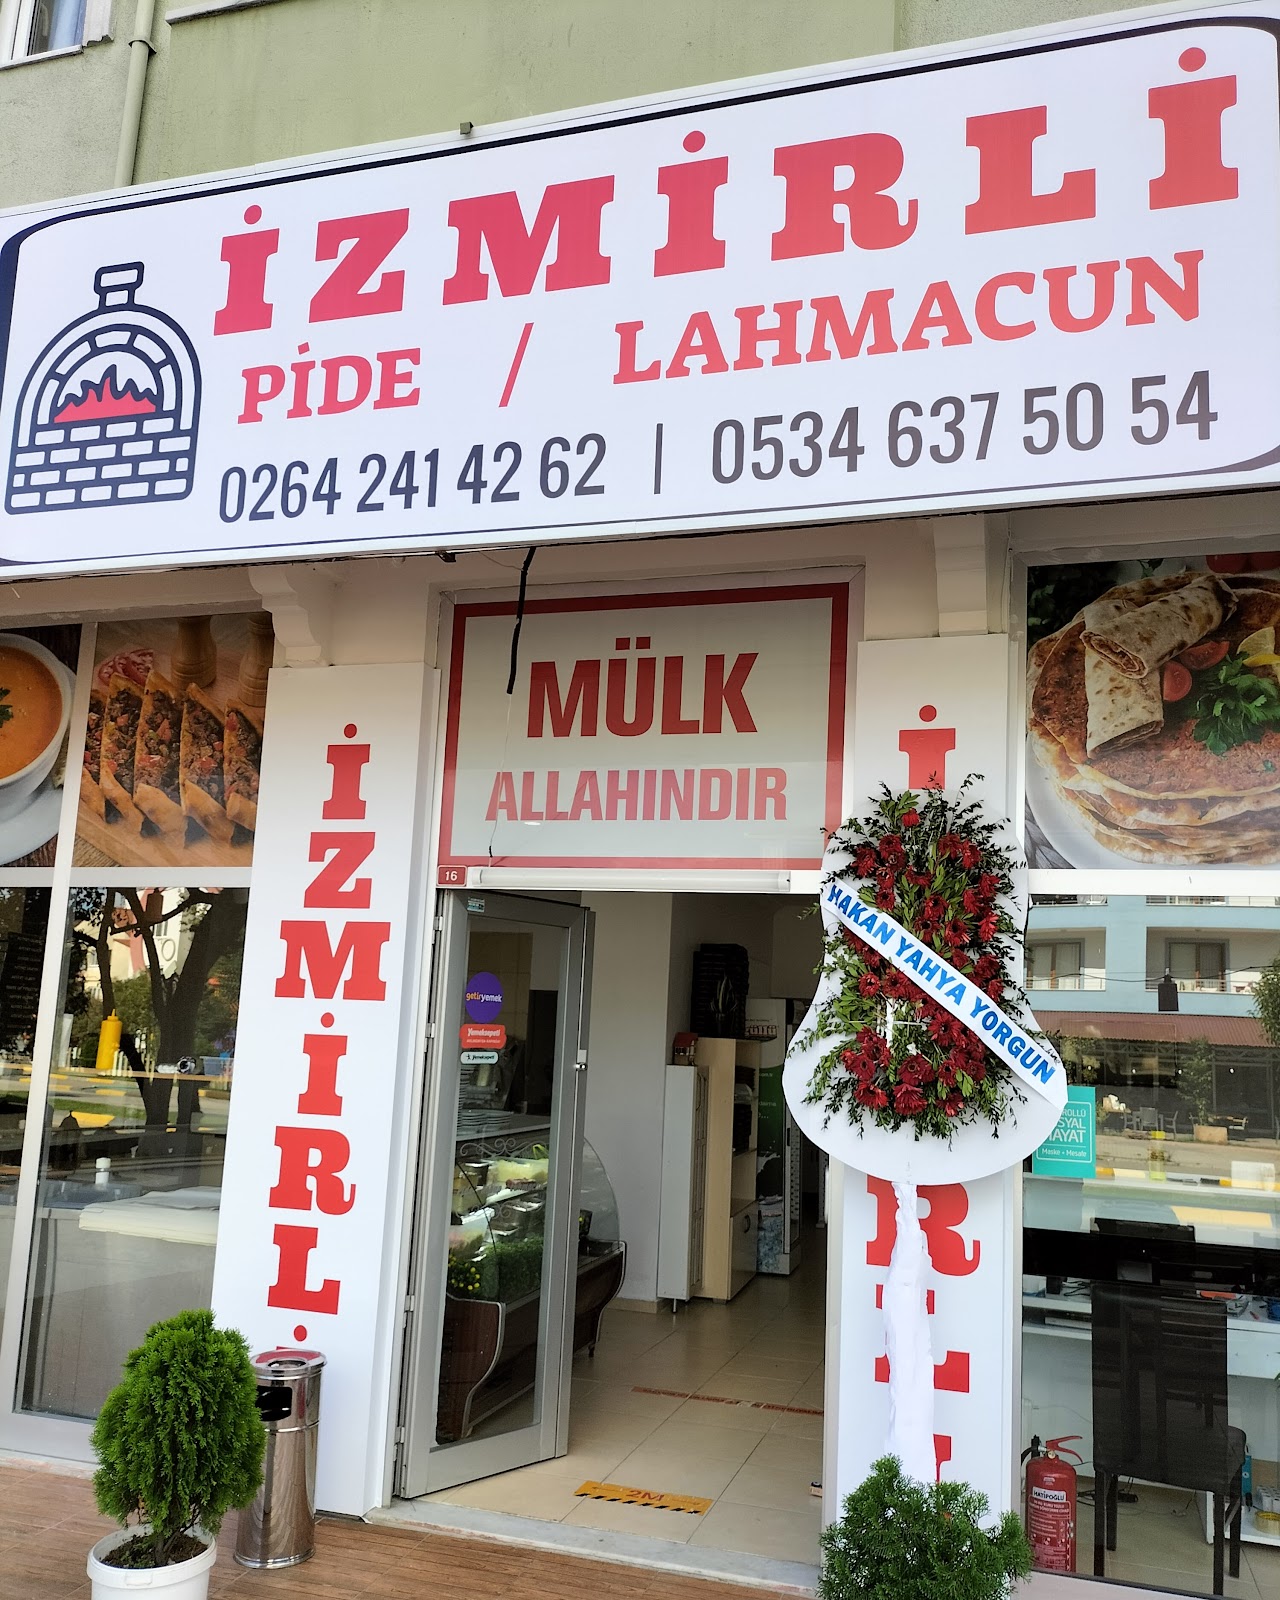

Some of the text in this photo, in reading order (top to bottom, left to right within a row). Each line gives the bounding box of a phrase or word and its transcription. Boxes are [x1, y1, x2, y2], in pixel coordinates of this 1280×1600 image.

[214, 47, 1239, 335] İZMİRLİ
[238, 342, 421, 424] PİDE
[613, 249, 1204, 384] LAHMACUN
[219, 370, 1219, 523] 0264 241 42 62 0534 637 50 54
[527, 636, 759, 738] MÜLK
[485, 767, 787, 821] ALLAHINDIR
[445, 870, 458, 882] 16
[827, 884, 1056, 1086] HAKAN YAHYA YORGUN
[267, 723, 391, 1350] İZMİRL
[1058, 1117, 1086, 1129] SYAL
[1066, 1149, 1087, 1157] Mesafe
[626, 1489, 665, 1501] 2M
